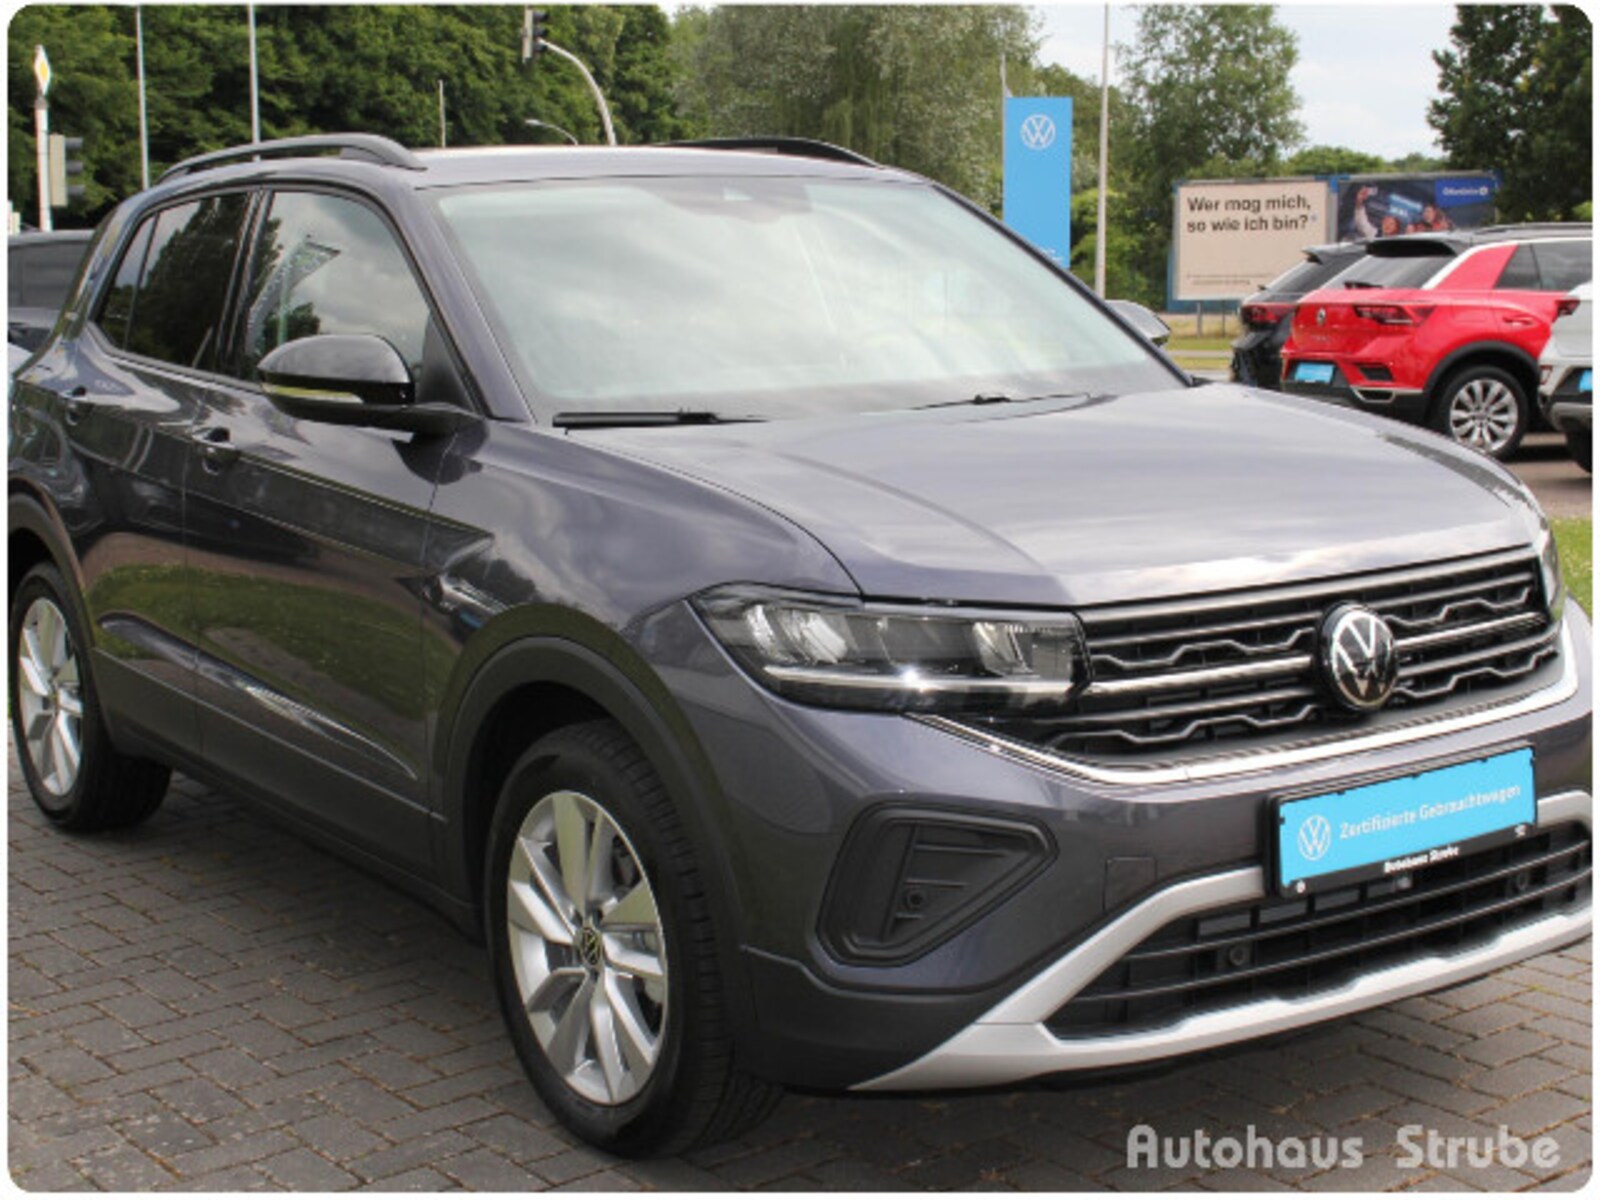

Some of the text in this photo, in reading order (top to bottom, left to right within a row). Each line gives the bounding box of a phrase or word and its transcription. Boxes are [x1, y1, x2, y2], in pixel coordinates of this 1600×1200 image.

[1187, 197, 1219, 212] Wer
[1265, 194, 1311, 210] mich,
[1187, 214, 1308, 232] so wie ich bin?
[1419, 785, 1521, 820] Gebrauchtwagen
